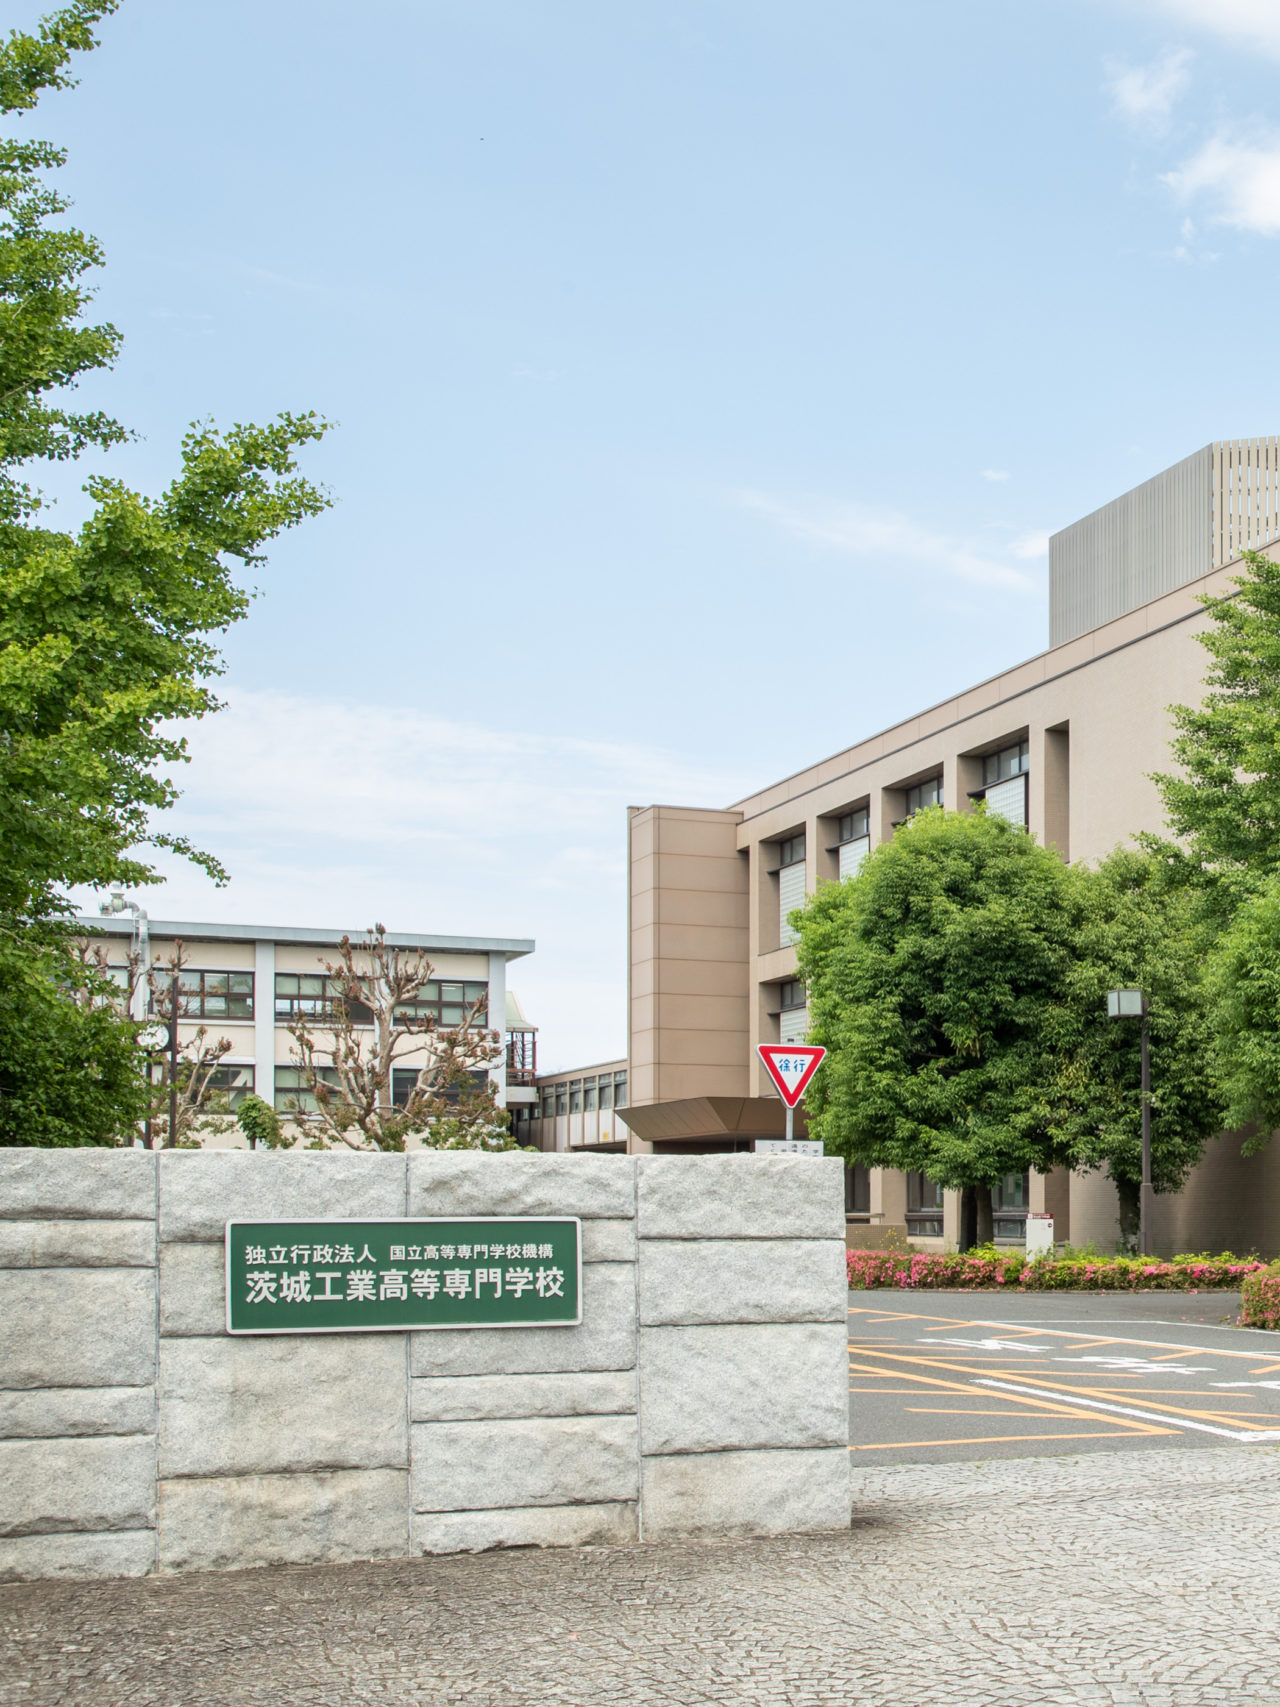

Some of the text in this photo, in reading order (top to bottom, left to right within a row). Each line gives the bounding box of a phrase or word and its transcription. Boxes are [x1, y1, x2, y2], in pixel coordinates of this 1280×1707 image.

[778, 1058, 806, 1073] 徐行
[245, 1243, 554, 1265] 独立行政法人 国立高等専門学校機構
[245, 1266, 566, 1304] 茨城工業高等専門学校
